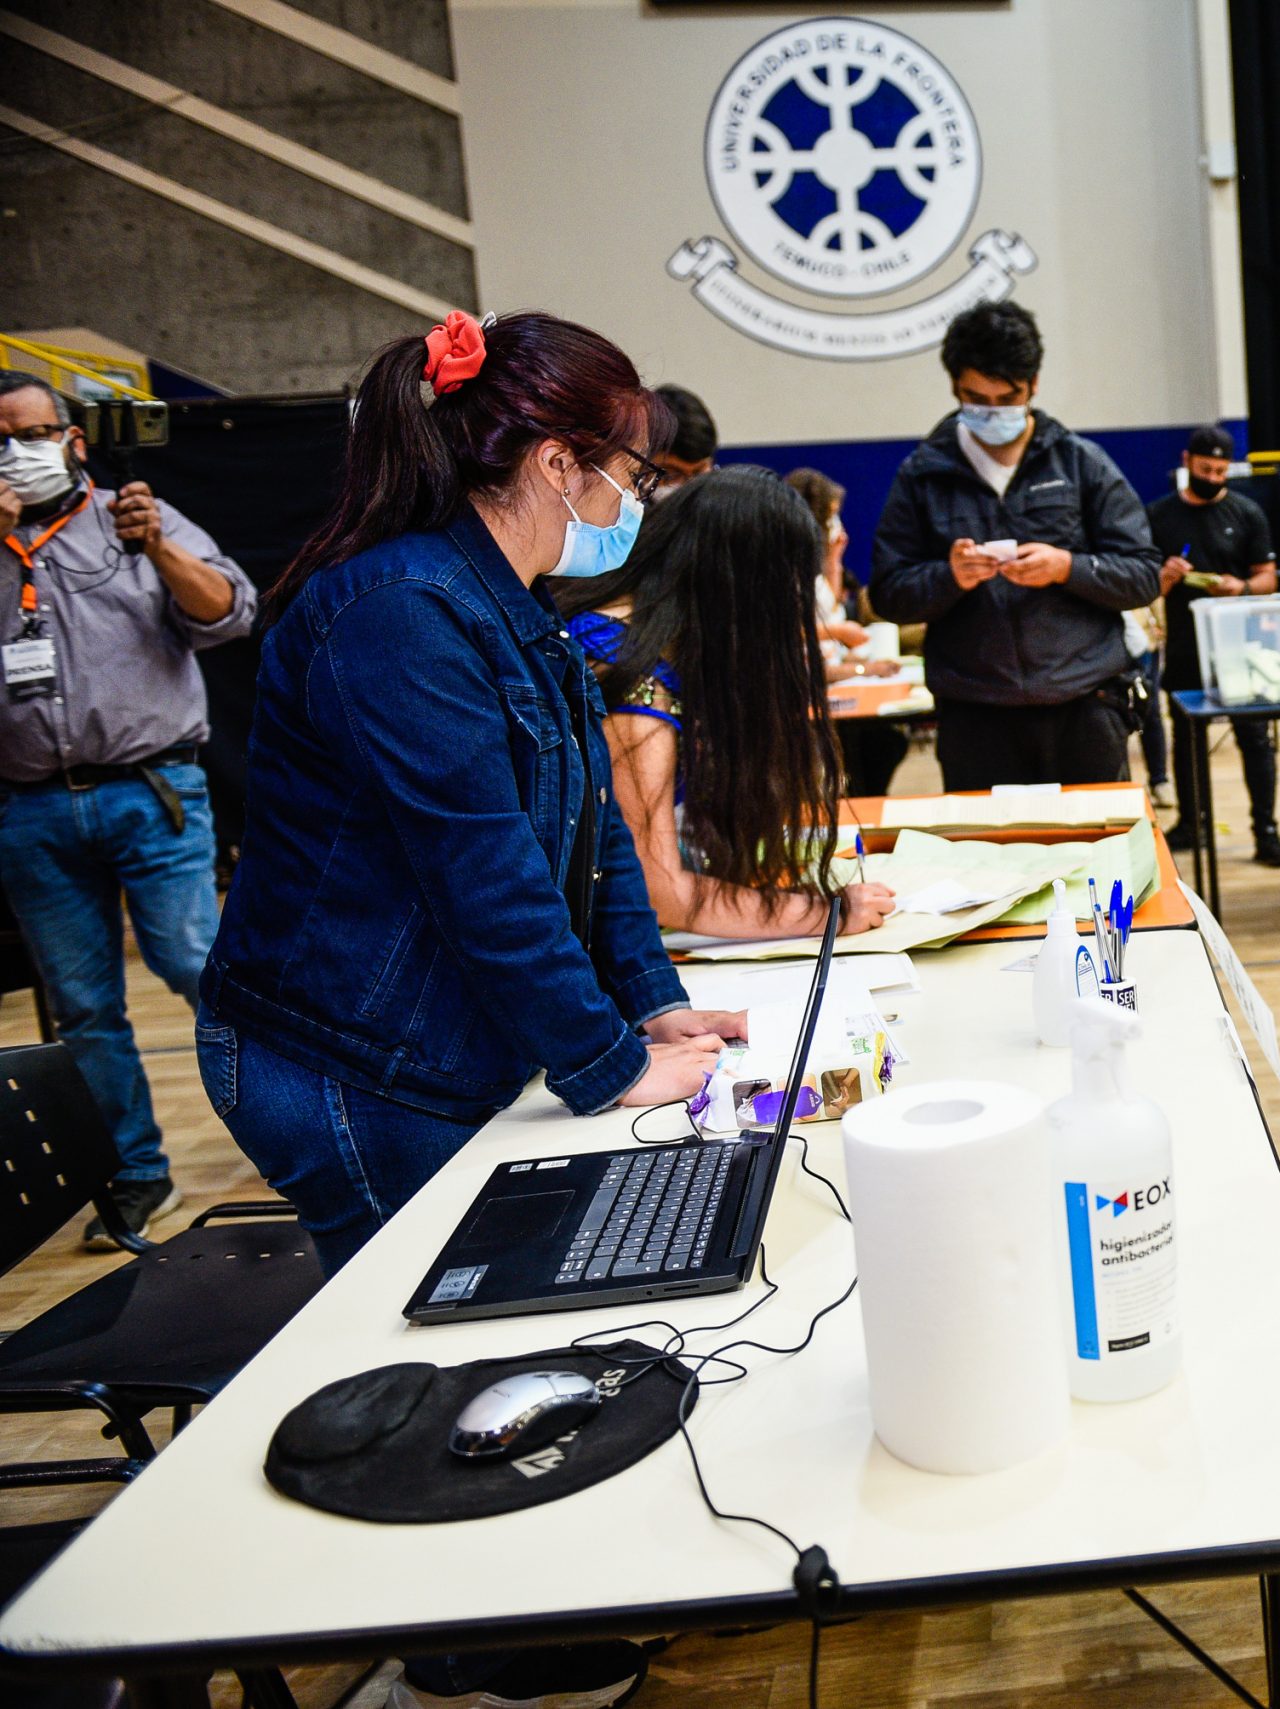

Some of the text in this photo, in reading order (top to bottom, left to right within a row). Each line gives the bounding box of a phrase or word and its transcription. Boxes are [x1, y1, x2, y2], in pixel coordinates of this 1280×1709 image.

[721, 33, 966, 171] UNIVERSIDAD DE LA FRONTERA
[774, 241, 911, 278] TEMUCO CHILE
[1118, 990, 1134, 1005] SER
[1100, 1221, 1173, 1252] higienizador
